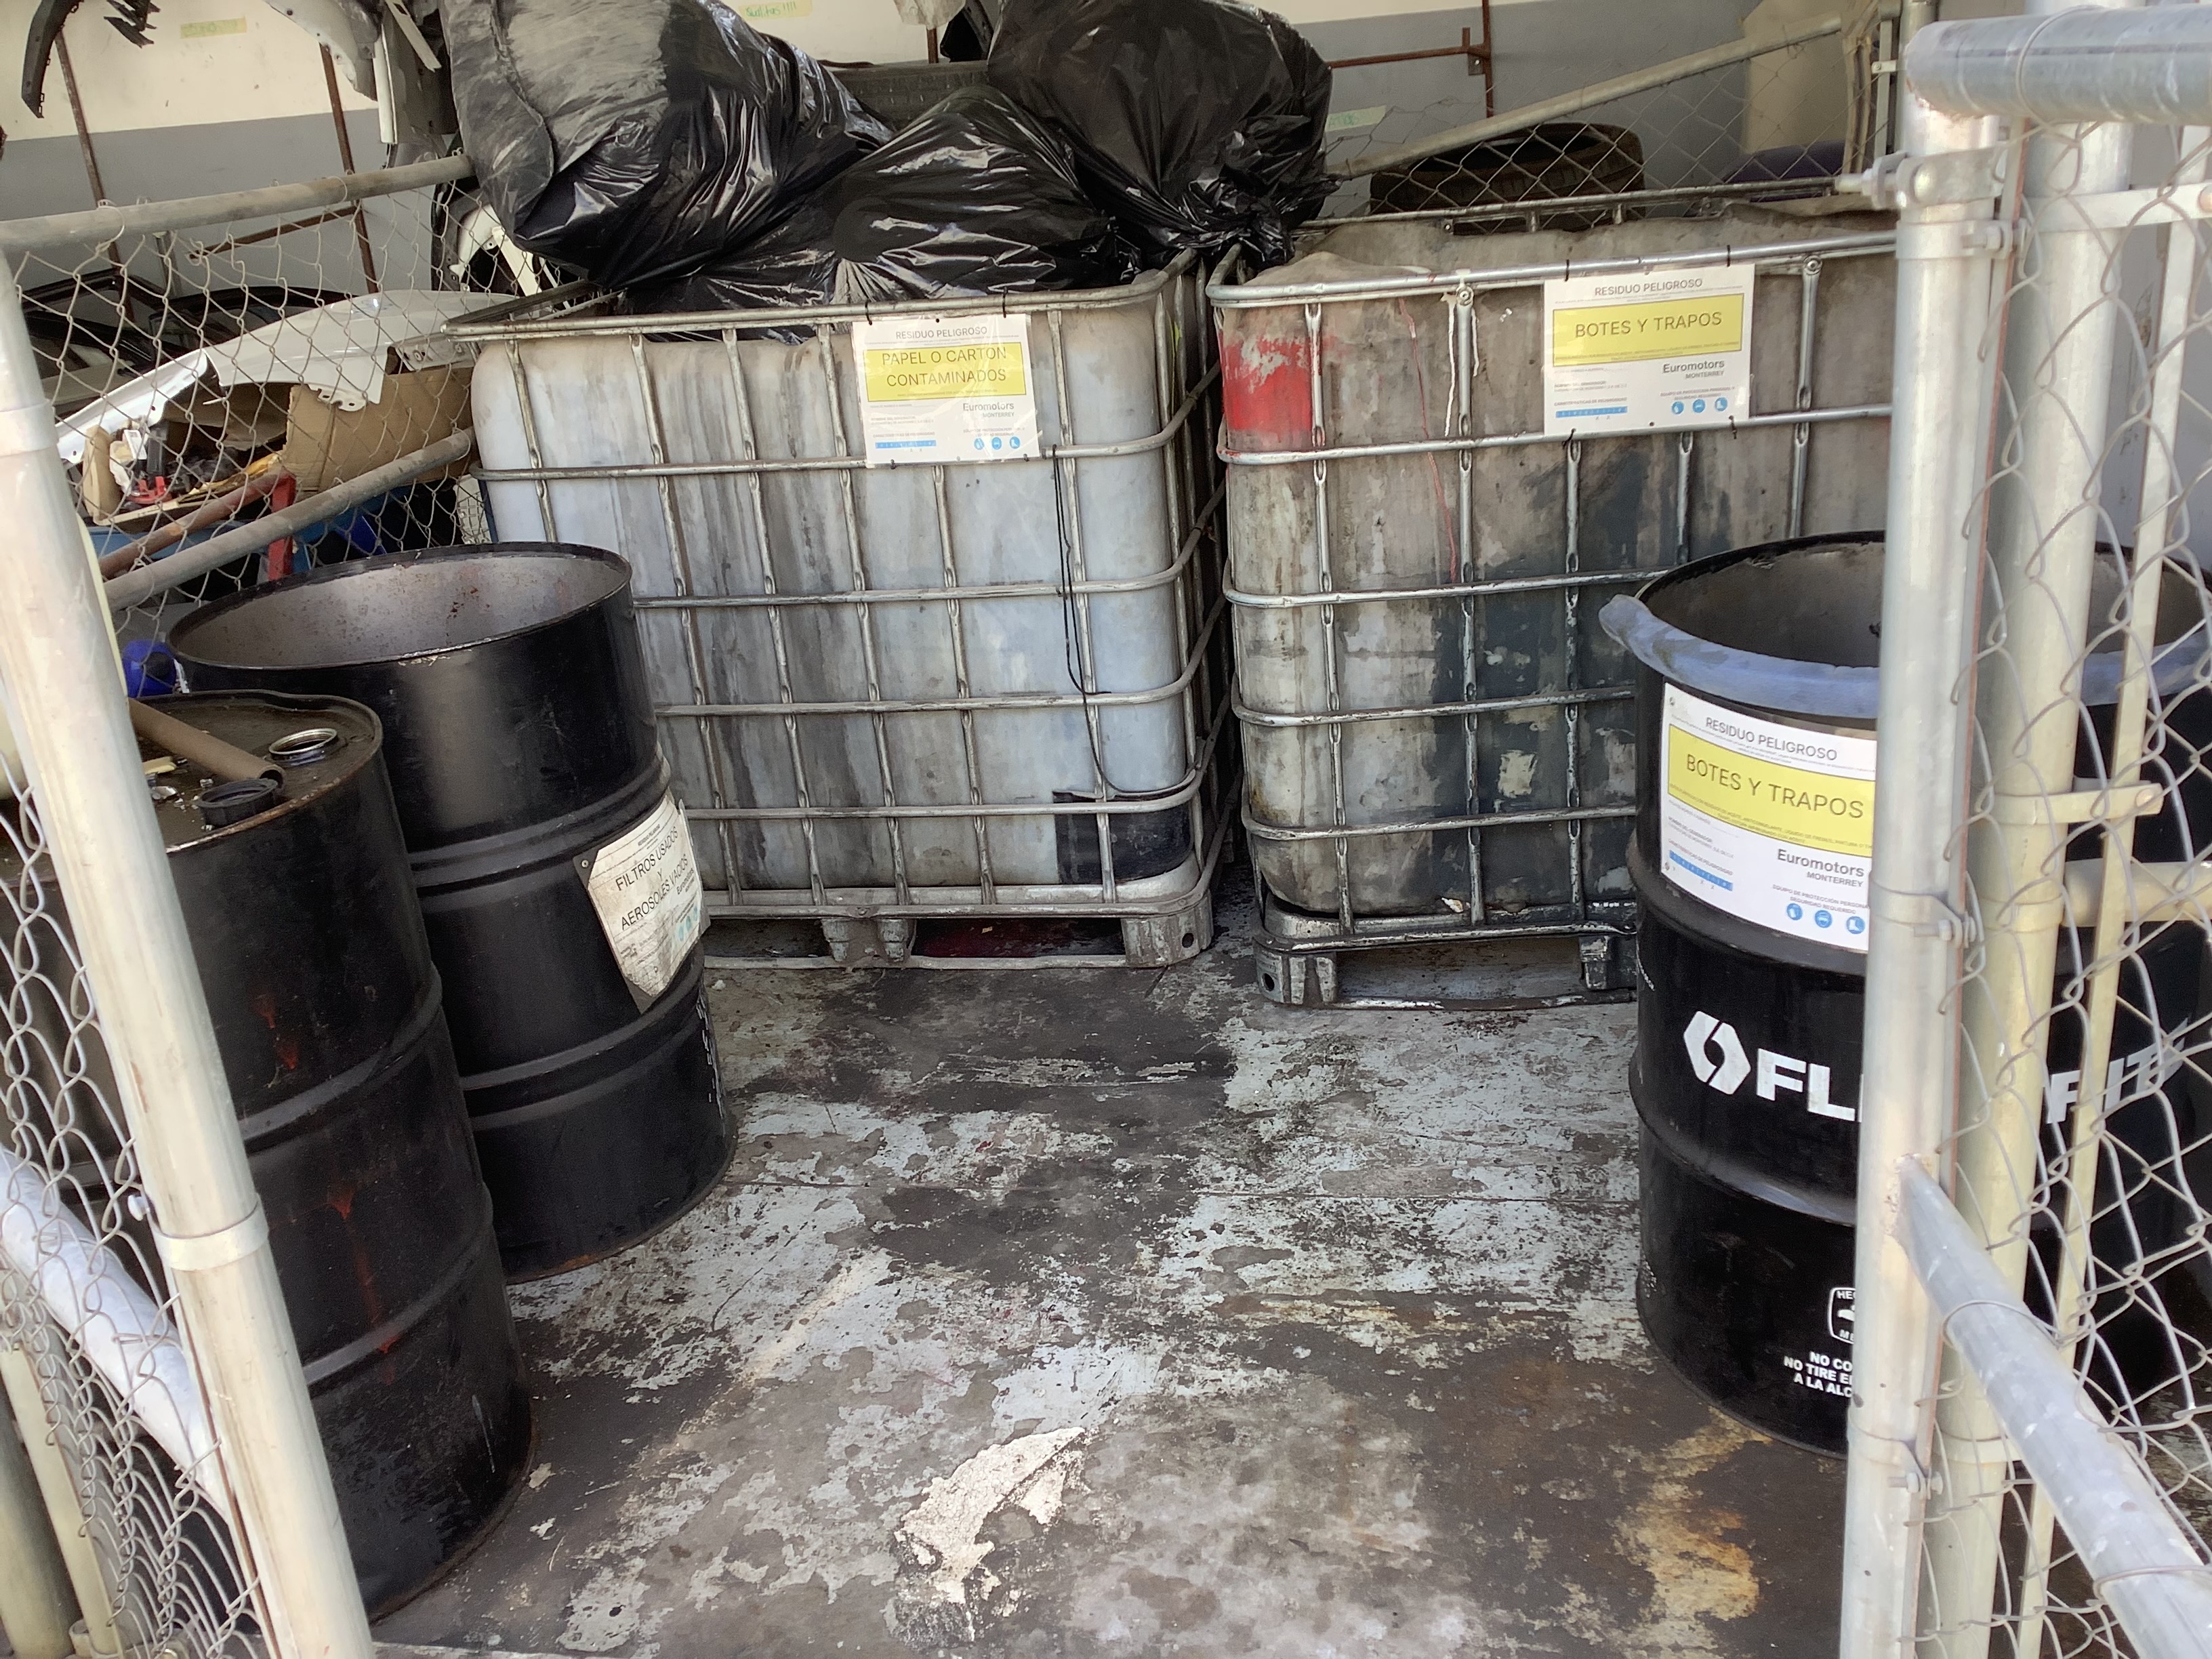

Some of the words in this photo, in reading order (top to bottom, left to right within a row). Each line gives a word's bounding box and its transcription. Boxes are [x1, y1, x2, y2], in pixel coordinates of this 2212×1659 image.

[1595, 284, 1641, 296] RESIDUO
[1643, 278, 1703, 292] PELIGROSO
[896, 329, 935, 340] RESIDUO
[937, 326, 987, 337] PELIGROSO
[1575, 320, 1631, 338] BOTES
[1637, 319, 1648, 333] Y
[1654, 311, 1723, 331] TRAPOS
[882, 350, 926, 365] PAPEL
[930, 350, 941, 363] O
[1662, 361, 1725, 373] Euromotors
[1685, 370, 1724, 380] MONTERREY
[886, 368, 1006, 387] CONTAMINADOS
[963, 402, 1015, 411] Euromotors
[1706, 717, 1755, 743] RESIDUO
[1758, 735, 1837, 761] PELIGROSO
[1687, 754, 1742, 791] BOTES
[1748, 777, 1761, 796] Y
[1768, 783, 1864, 819] TRAPOS
[615, 853, 657, 891] FILTROS
[655, 825, 678, 861] USADOS
[1778, 848, 1865, 878] Euromotors
[657, 867, 663, 882] Y
[1807, 871, 1864, 888] MONTERREY
[621, 878, 670, 930] AEROSOLES
[1809, 1351, 1830, 1366] NO
[1784, 1355, 1803, 1371] NO
[1805, 1364, 1837, 1381] TIRE
[1840, 1373, 1852, 1385] E
[1794, 1372, 1803, 1385] A
[1806, 1376, 1824, 1391] LA
